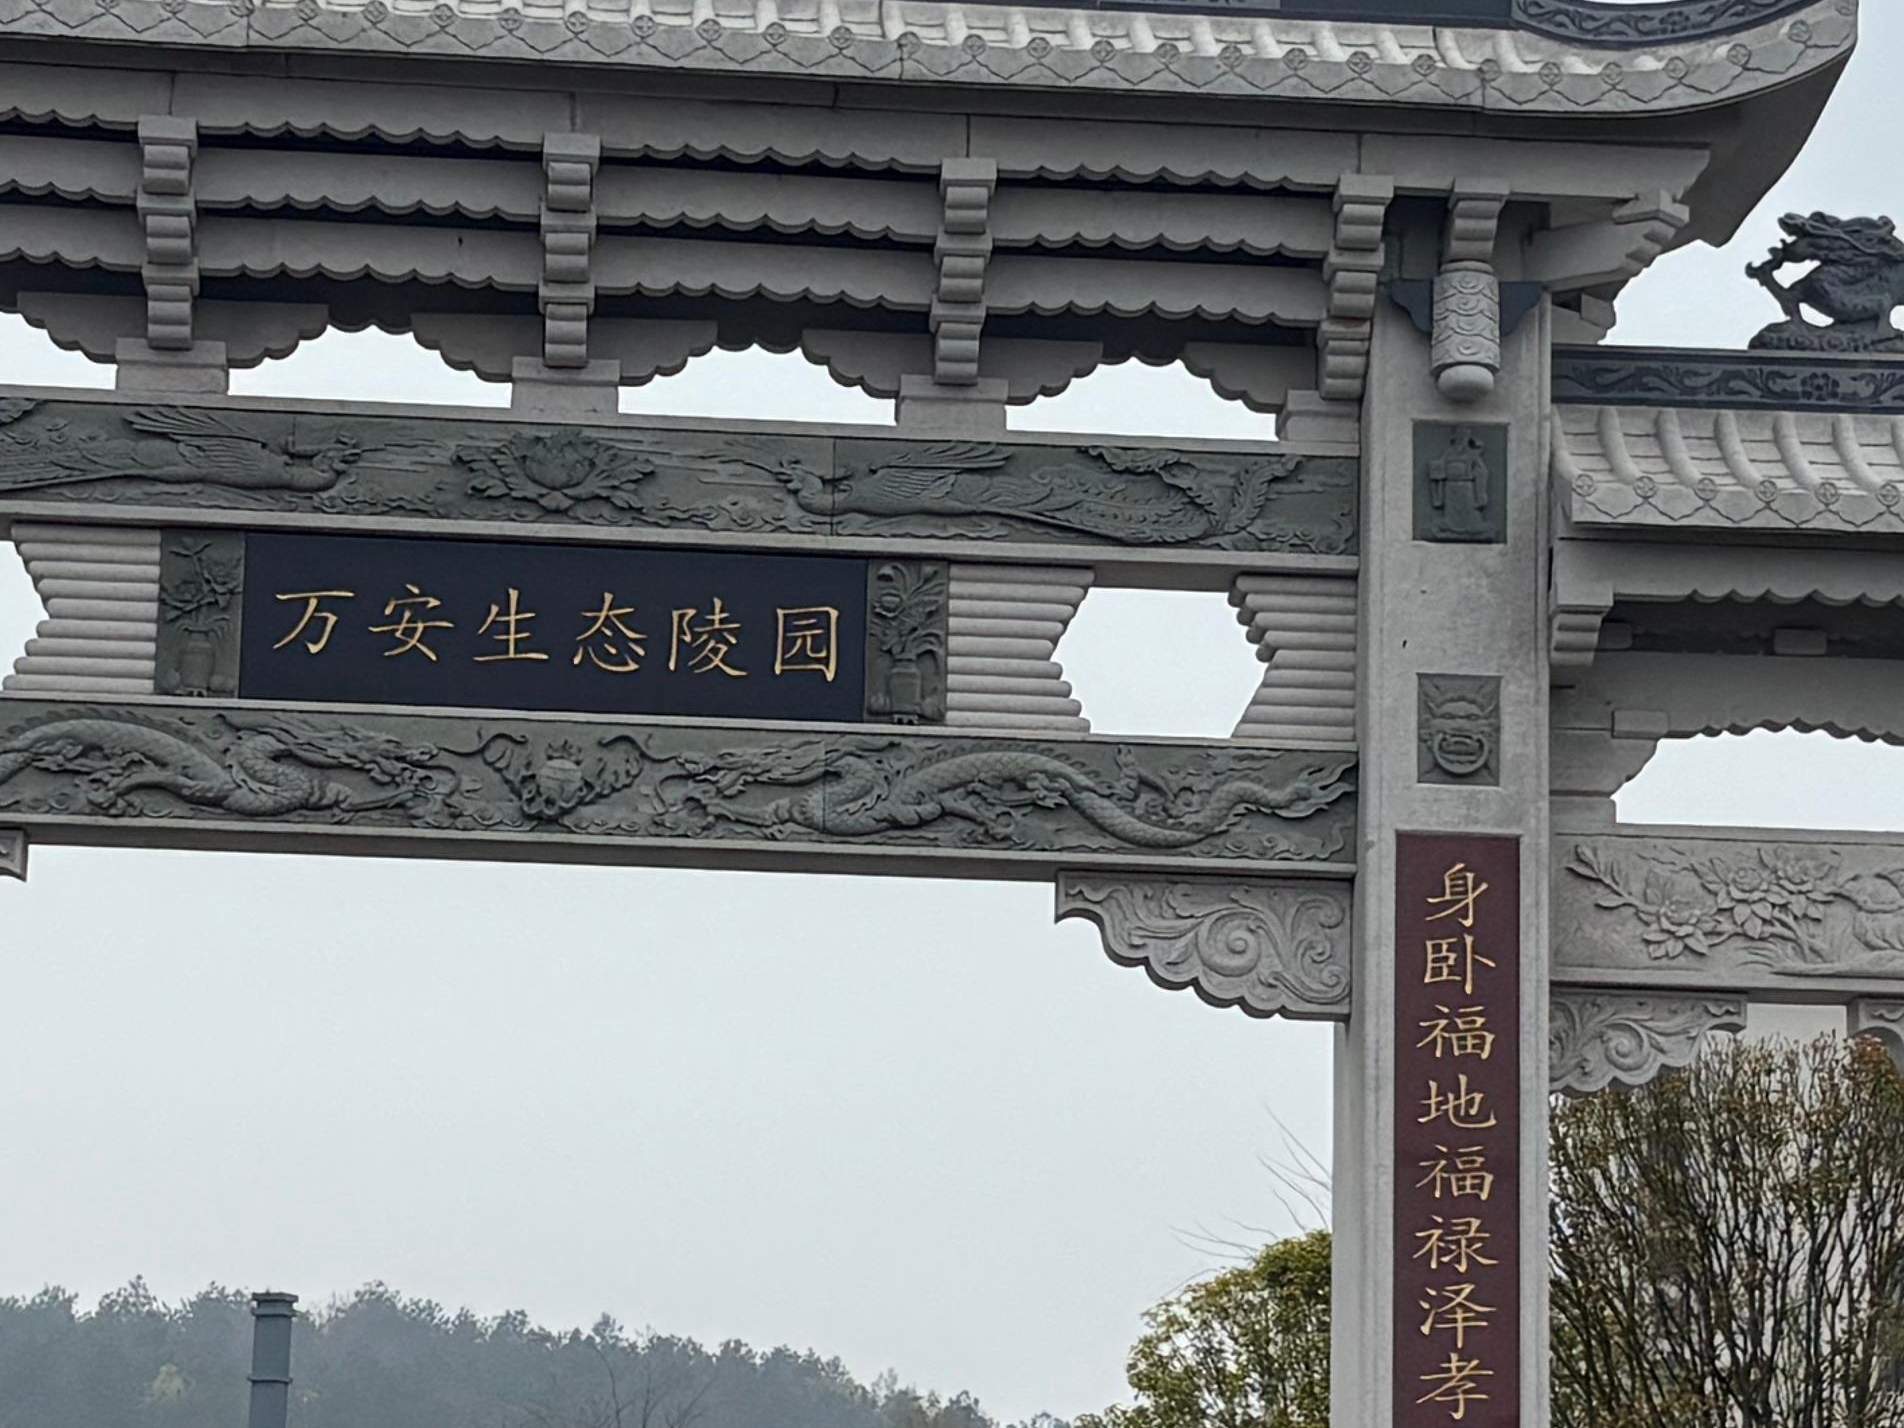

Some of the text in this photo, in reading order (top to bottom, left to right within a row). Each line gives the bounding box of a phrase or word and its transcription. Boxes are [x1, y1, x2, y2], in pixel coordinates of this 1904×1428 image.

[272, 584, 842, 683] 万安生态陵园
